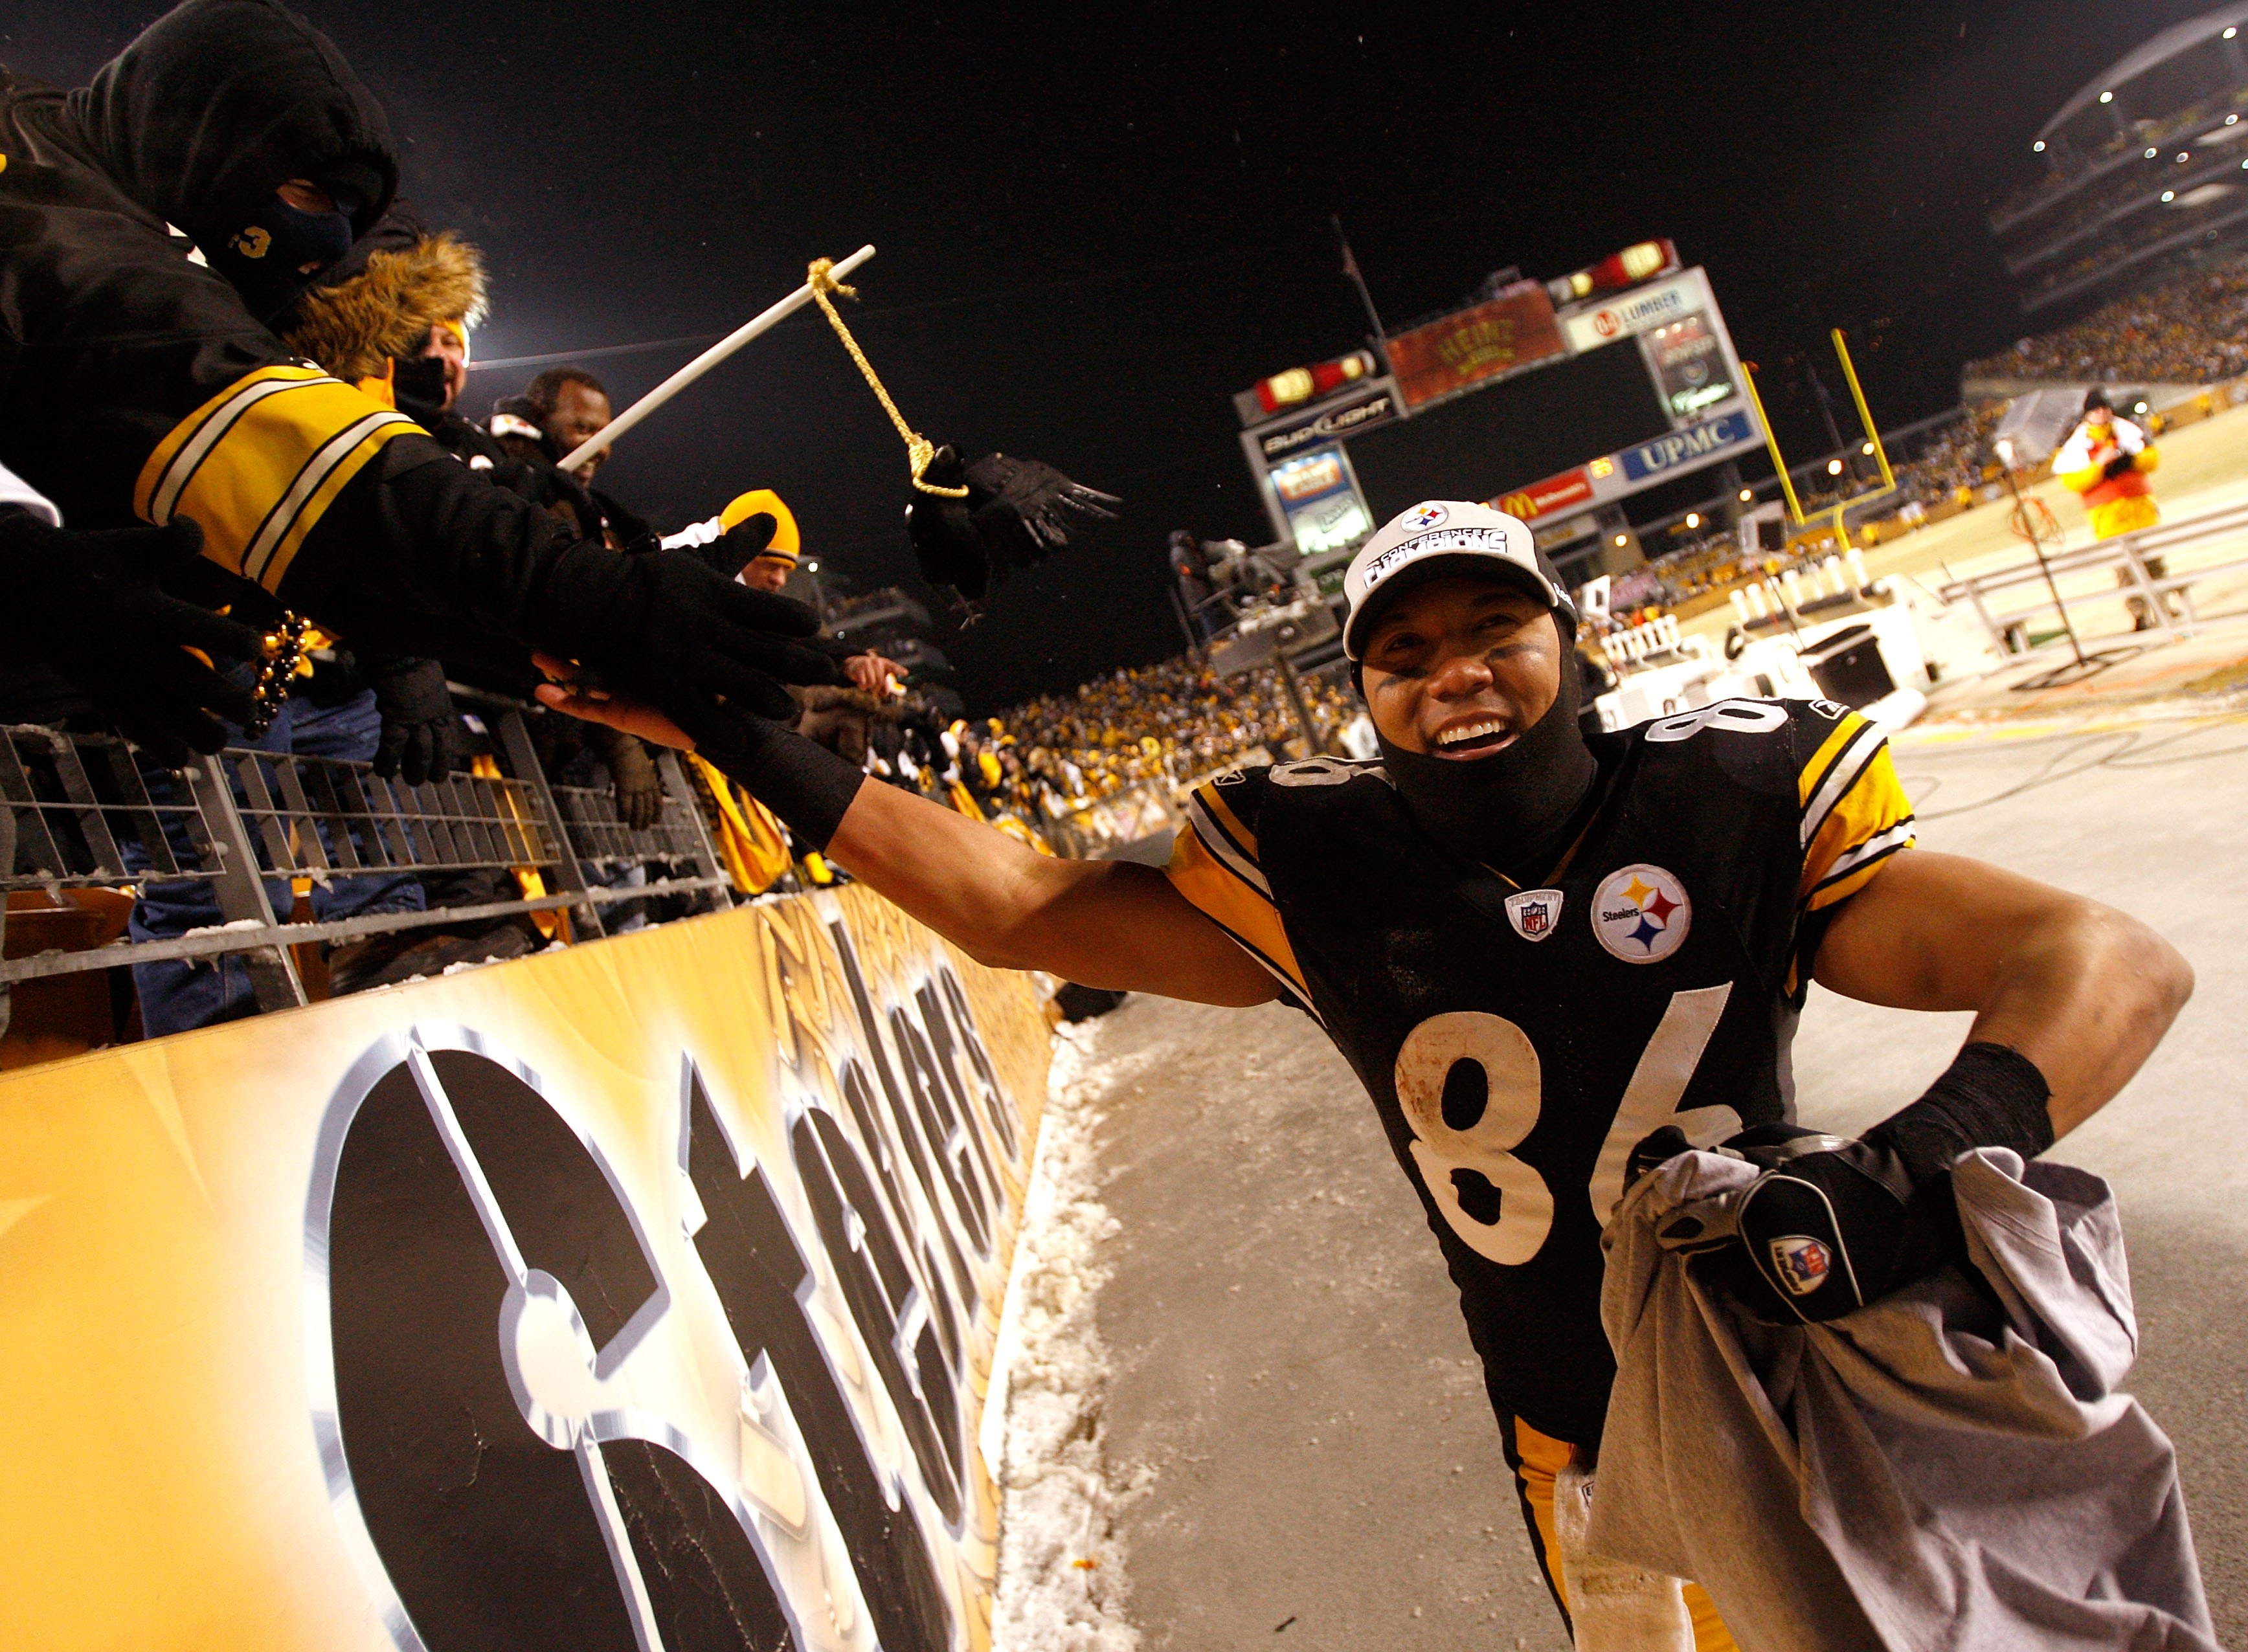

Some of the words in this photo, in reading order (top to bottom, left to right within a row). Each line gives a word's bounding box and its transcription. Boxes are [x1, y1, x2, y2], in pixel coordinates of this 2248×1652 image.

[1621, 290, 1683, 322] LUMBER
[1639, 418, 1736, 471] UPMC
[1380, 528, 1483, 563] CONFERENCE
[1523, 915, 1547, 932] NFL
[1602, 908, 1639, 922] Steelers
[1395, 980, 1743, 1266] 86
